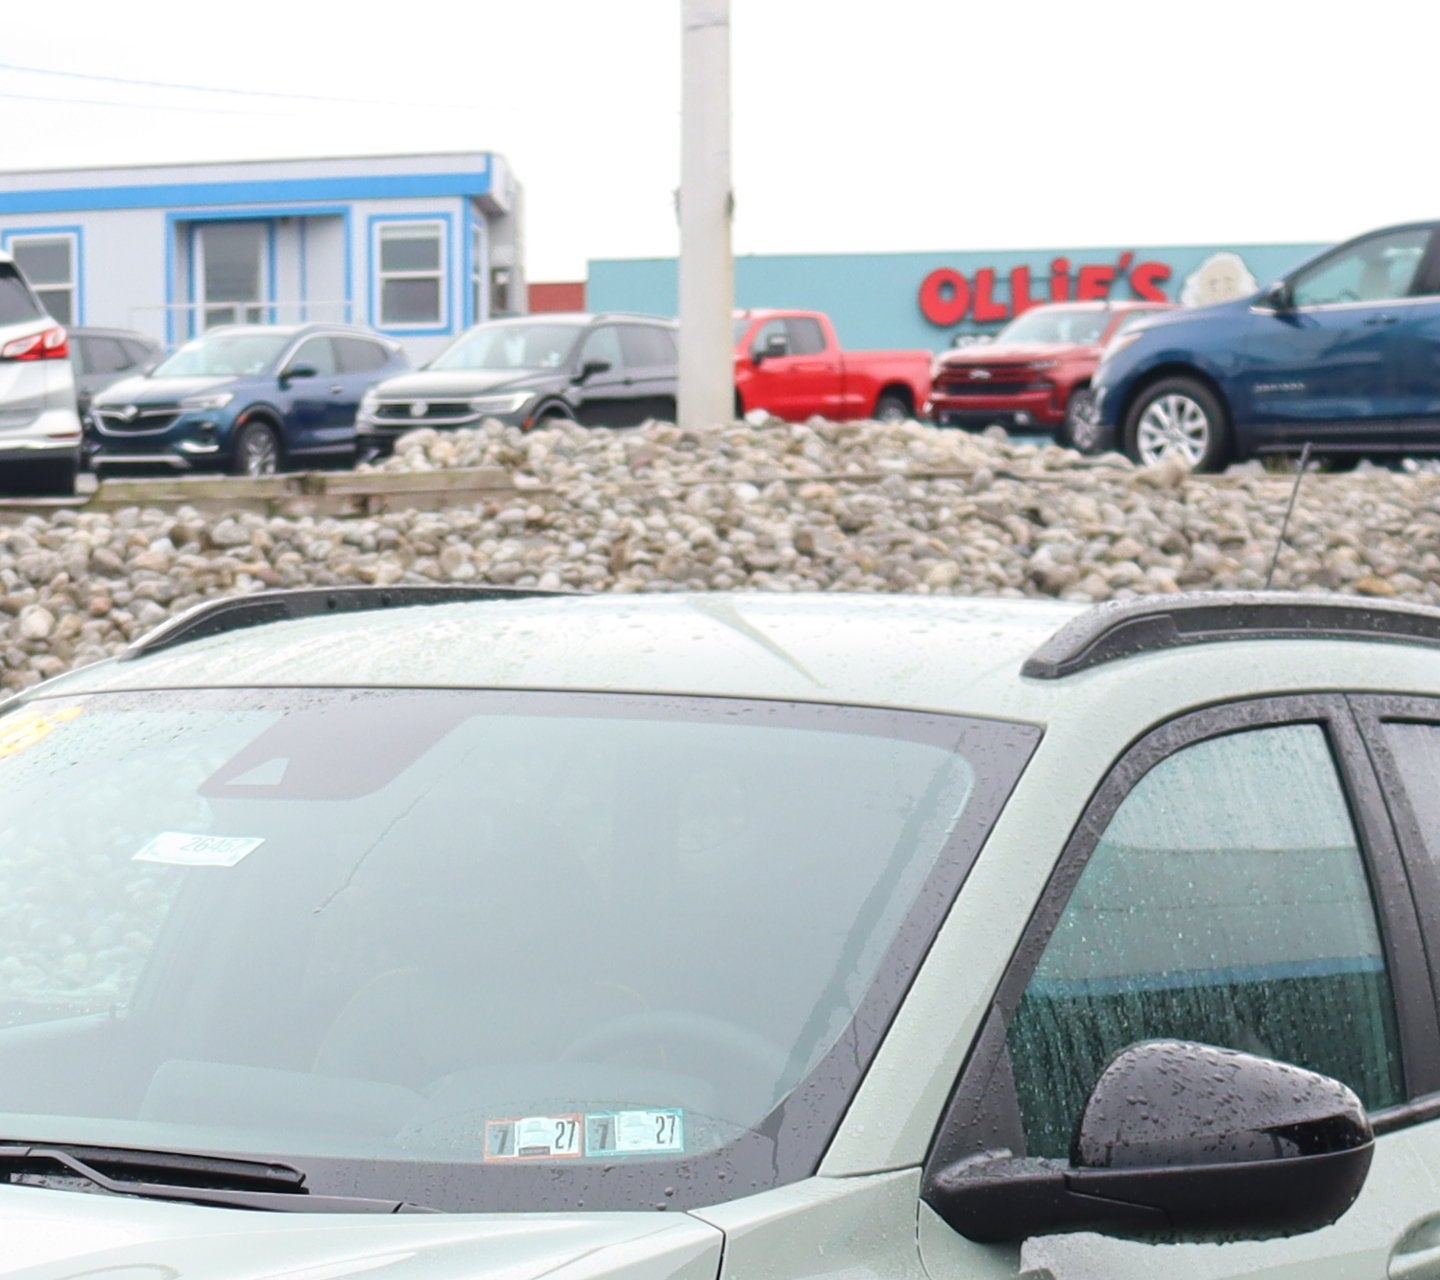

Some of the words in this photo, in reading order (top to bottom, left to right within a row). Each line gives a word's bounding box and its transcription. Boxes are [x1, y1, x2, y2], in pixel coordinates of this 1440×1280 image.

[496, 1129, 509, 1155] 7
[555, 1120, 577, 1149] 27
[596, 1124, 609, 1150] 7
[655, 1115, 676, 1145] 27
